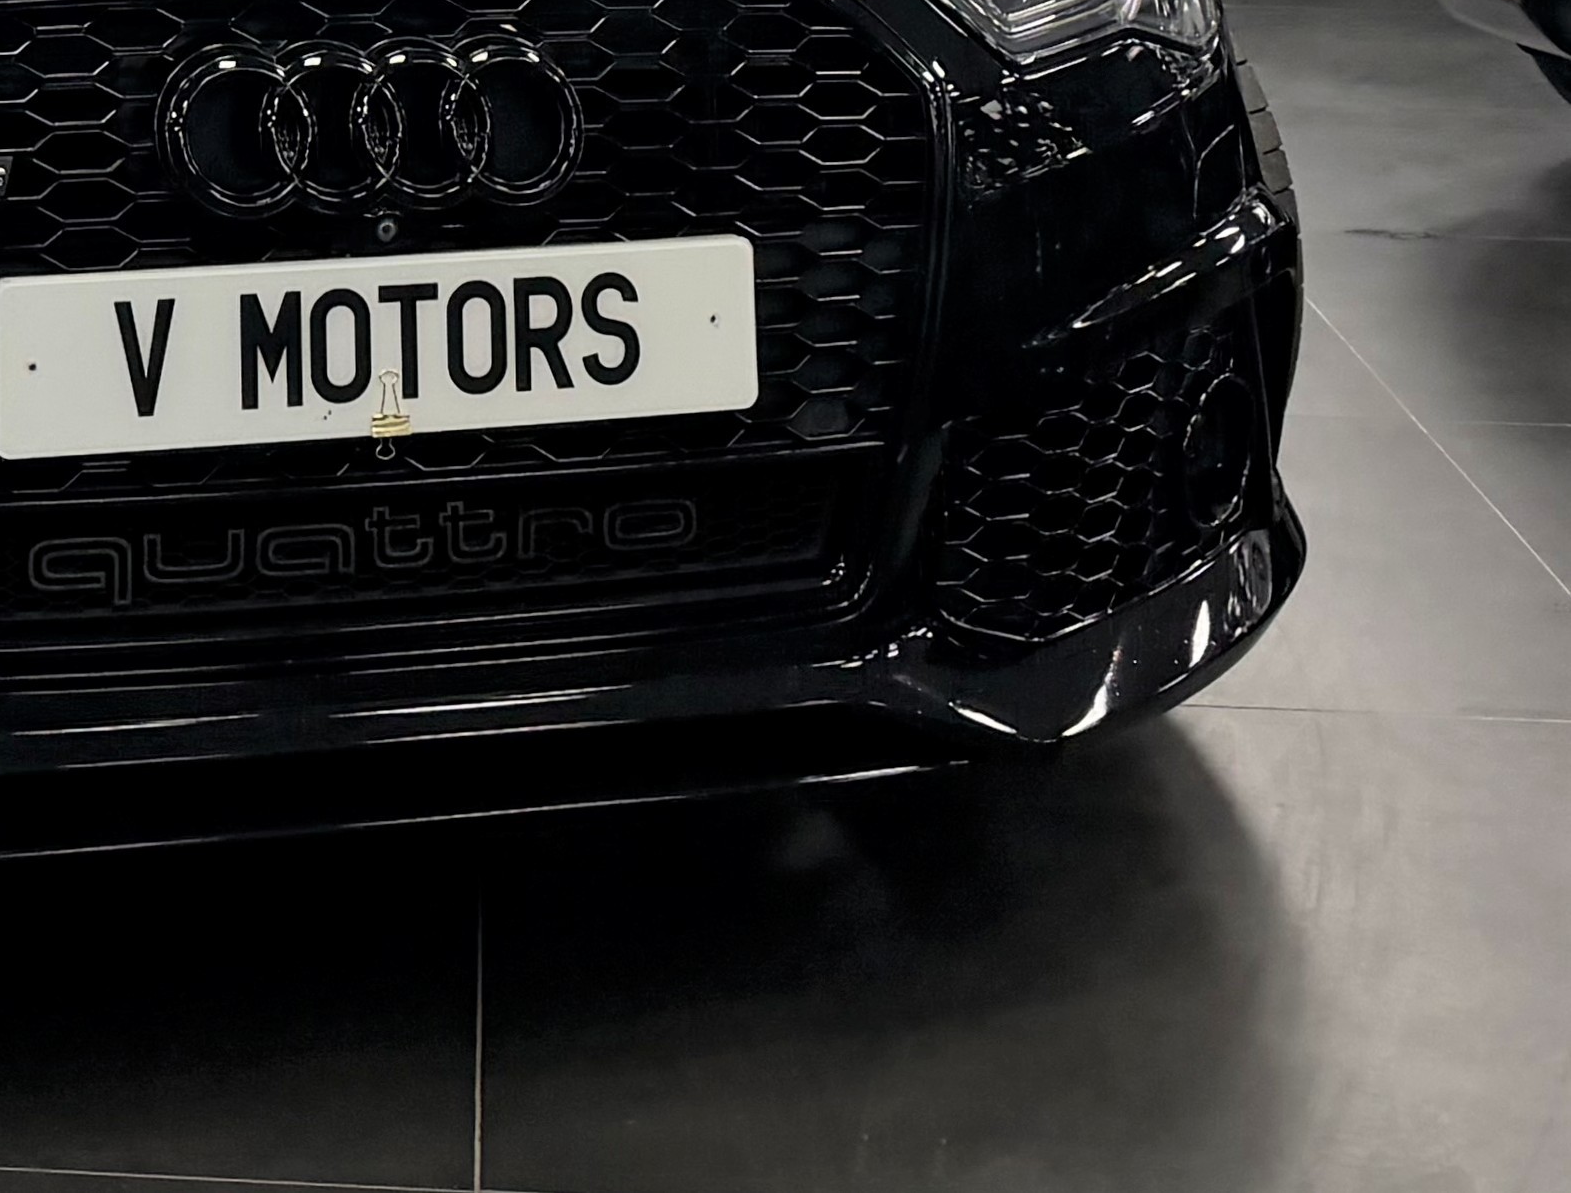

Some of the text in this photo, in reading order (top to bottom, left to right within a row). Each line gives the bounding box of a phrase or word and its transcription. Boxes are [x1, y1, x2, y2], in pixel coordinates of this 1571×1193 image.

[114, 271, 641, 417] V MOTORS
[30, 499, 697, 605] quattro
